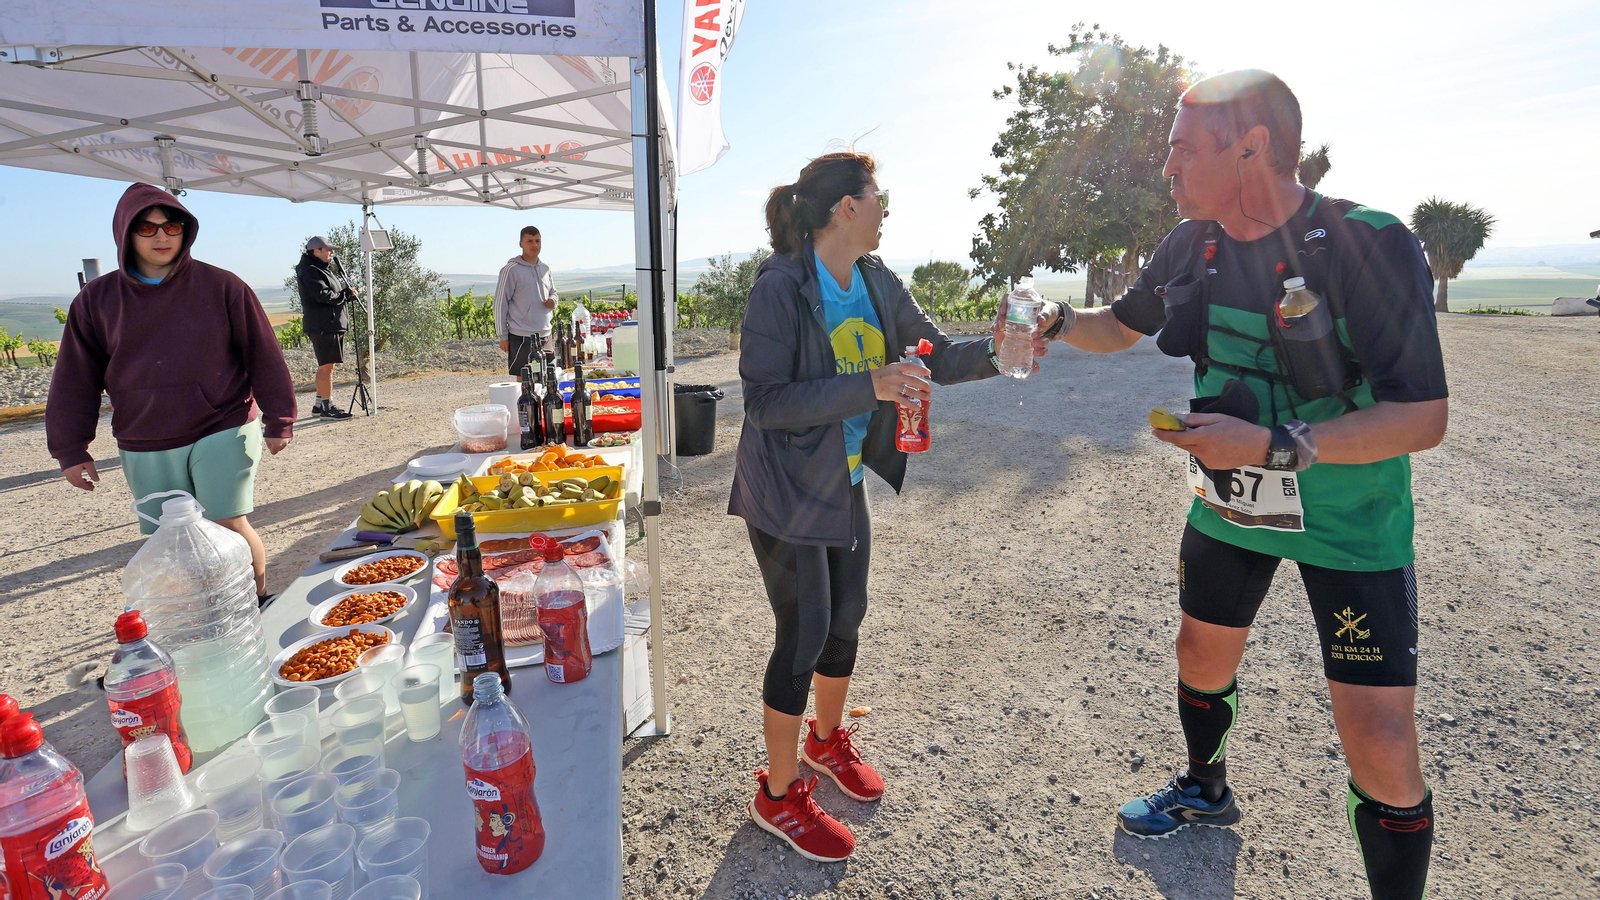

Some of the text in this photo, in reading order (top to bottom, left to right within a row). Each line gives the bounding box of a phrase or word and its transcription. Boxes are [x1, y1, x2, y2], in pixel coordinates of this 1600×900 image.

[321, 13, 577, 38] Parts & Accessories
[692, 0, 720, 57] YA
[1331, 644, 1381, 654] 101 KM 24 H
[1331, 651, 1345, 660] XXII
[49, 820, 92, 855] Lanjarón
